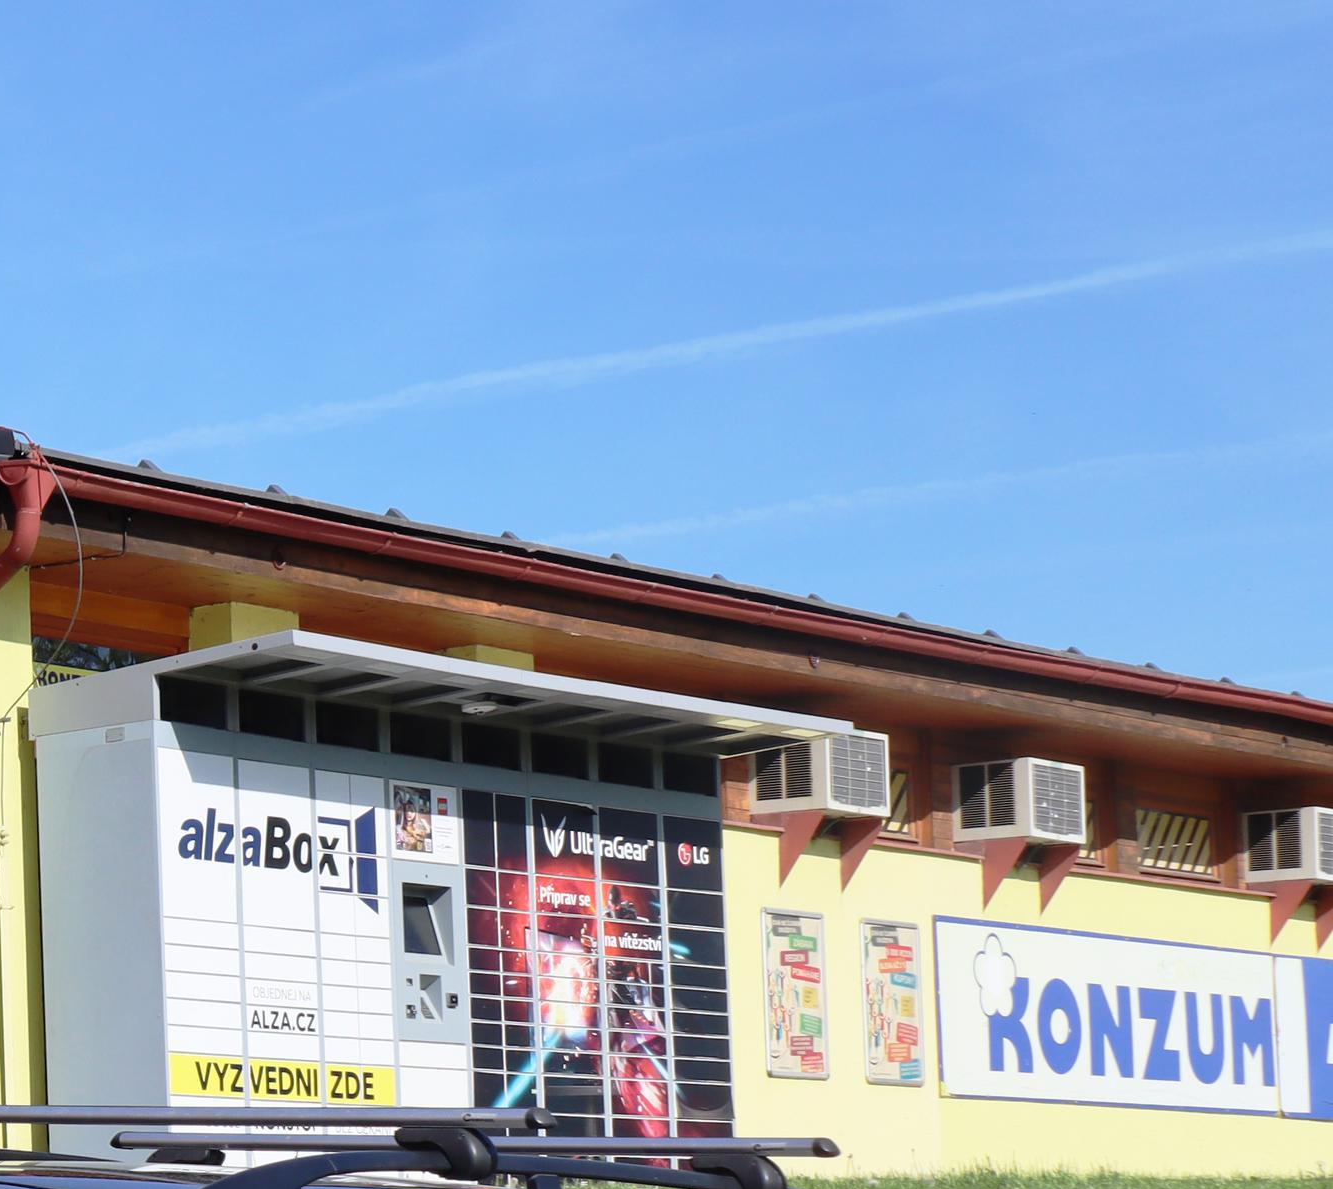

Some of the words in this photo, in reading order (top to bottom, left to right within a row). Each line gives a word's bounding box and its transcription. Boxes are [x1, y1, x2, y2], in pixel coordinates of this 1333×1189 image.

[178, 808, 339, 876] alzaBox
[693, 846, 710, 865] LG
[579, 895, 591, 907] se
[604, 937, 618, 948] na
[618, 932, 662, 951] vítězství
[252, 985, 297, 1001] OBJEDNEJ
[298, 989, 311, 1002] NA
[251, 1009, 316, 1033] ALZA.CZ
[988, 976, 1277, 1088] KONZUM
[195, 1061, 319, 1097] VYZVEDNI
[330, 1070, 375, 1100] ZDE
